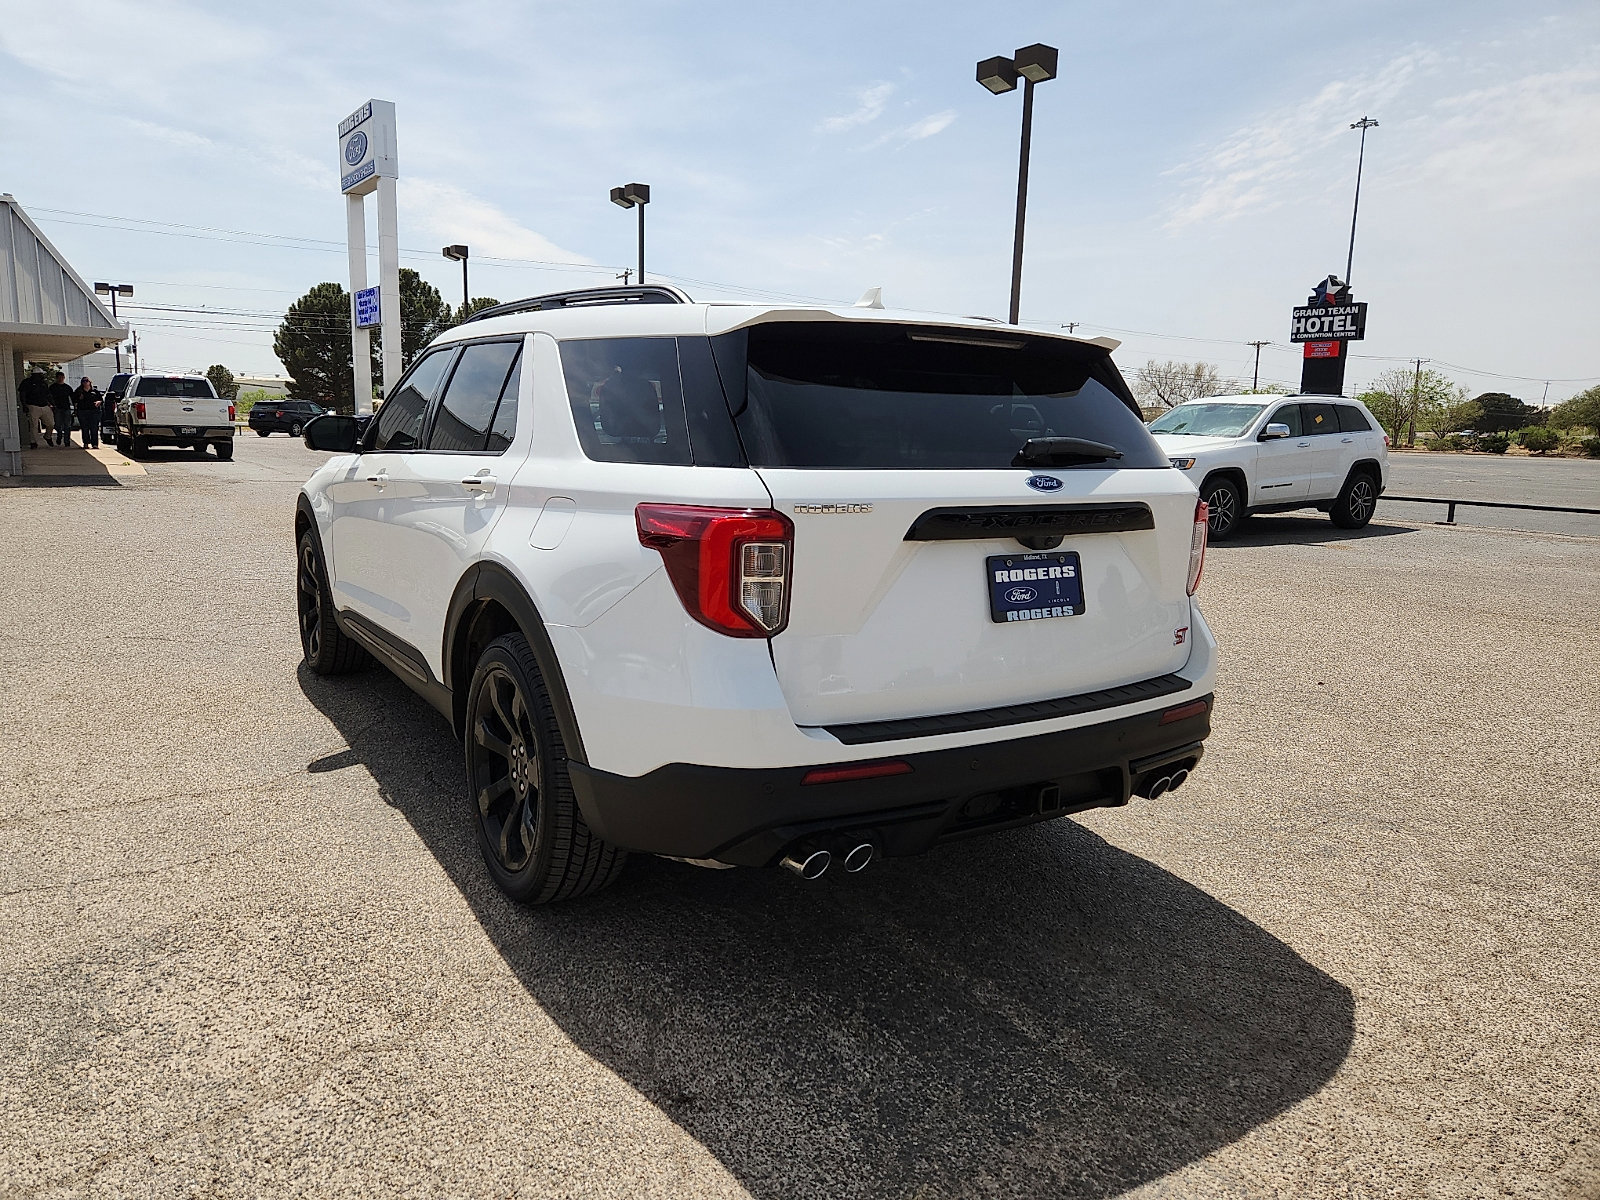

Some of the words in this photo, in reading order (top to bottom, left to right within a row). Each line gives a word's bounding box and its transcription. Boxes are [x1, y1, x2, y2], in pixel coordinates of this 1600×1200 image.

[340, 104, 370, 135] ROGERS
[1294, 308, 1325, 317] GRAND
[1328, 306, 1358, 315] TEXAN
[1292, 315, 1356, 333] HOTEL
[1036, 476, 1058, 488] Ford
[794, 503, 873, 514] ROGERS
[962, 512, 1126, 530] EXPLORER
[995, 566, 1075, 582] ROGERS
[1010, 589, 1031, 600] Ford
[1007, 606, 1074, 621] ROGERS
[1173, 626, 1188, 646] ST
